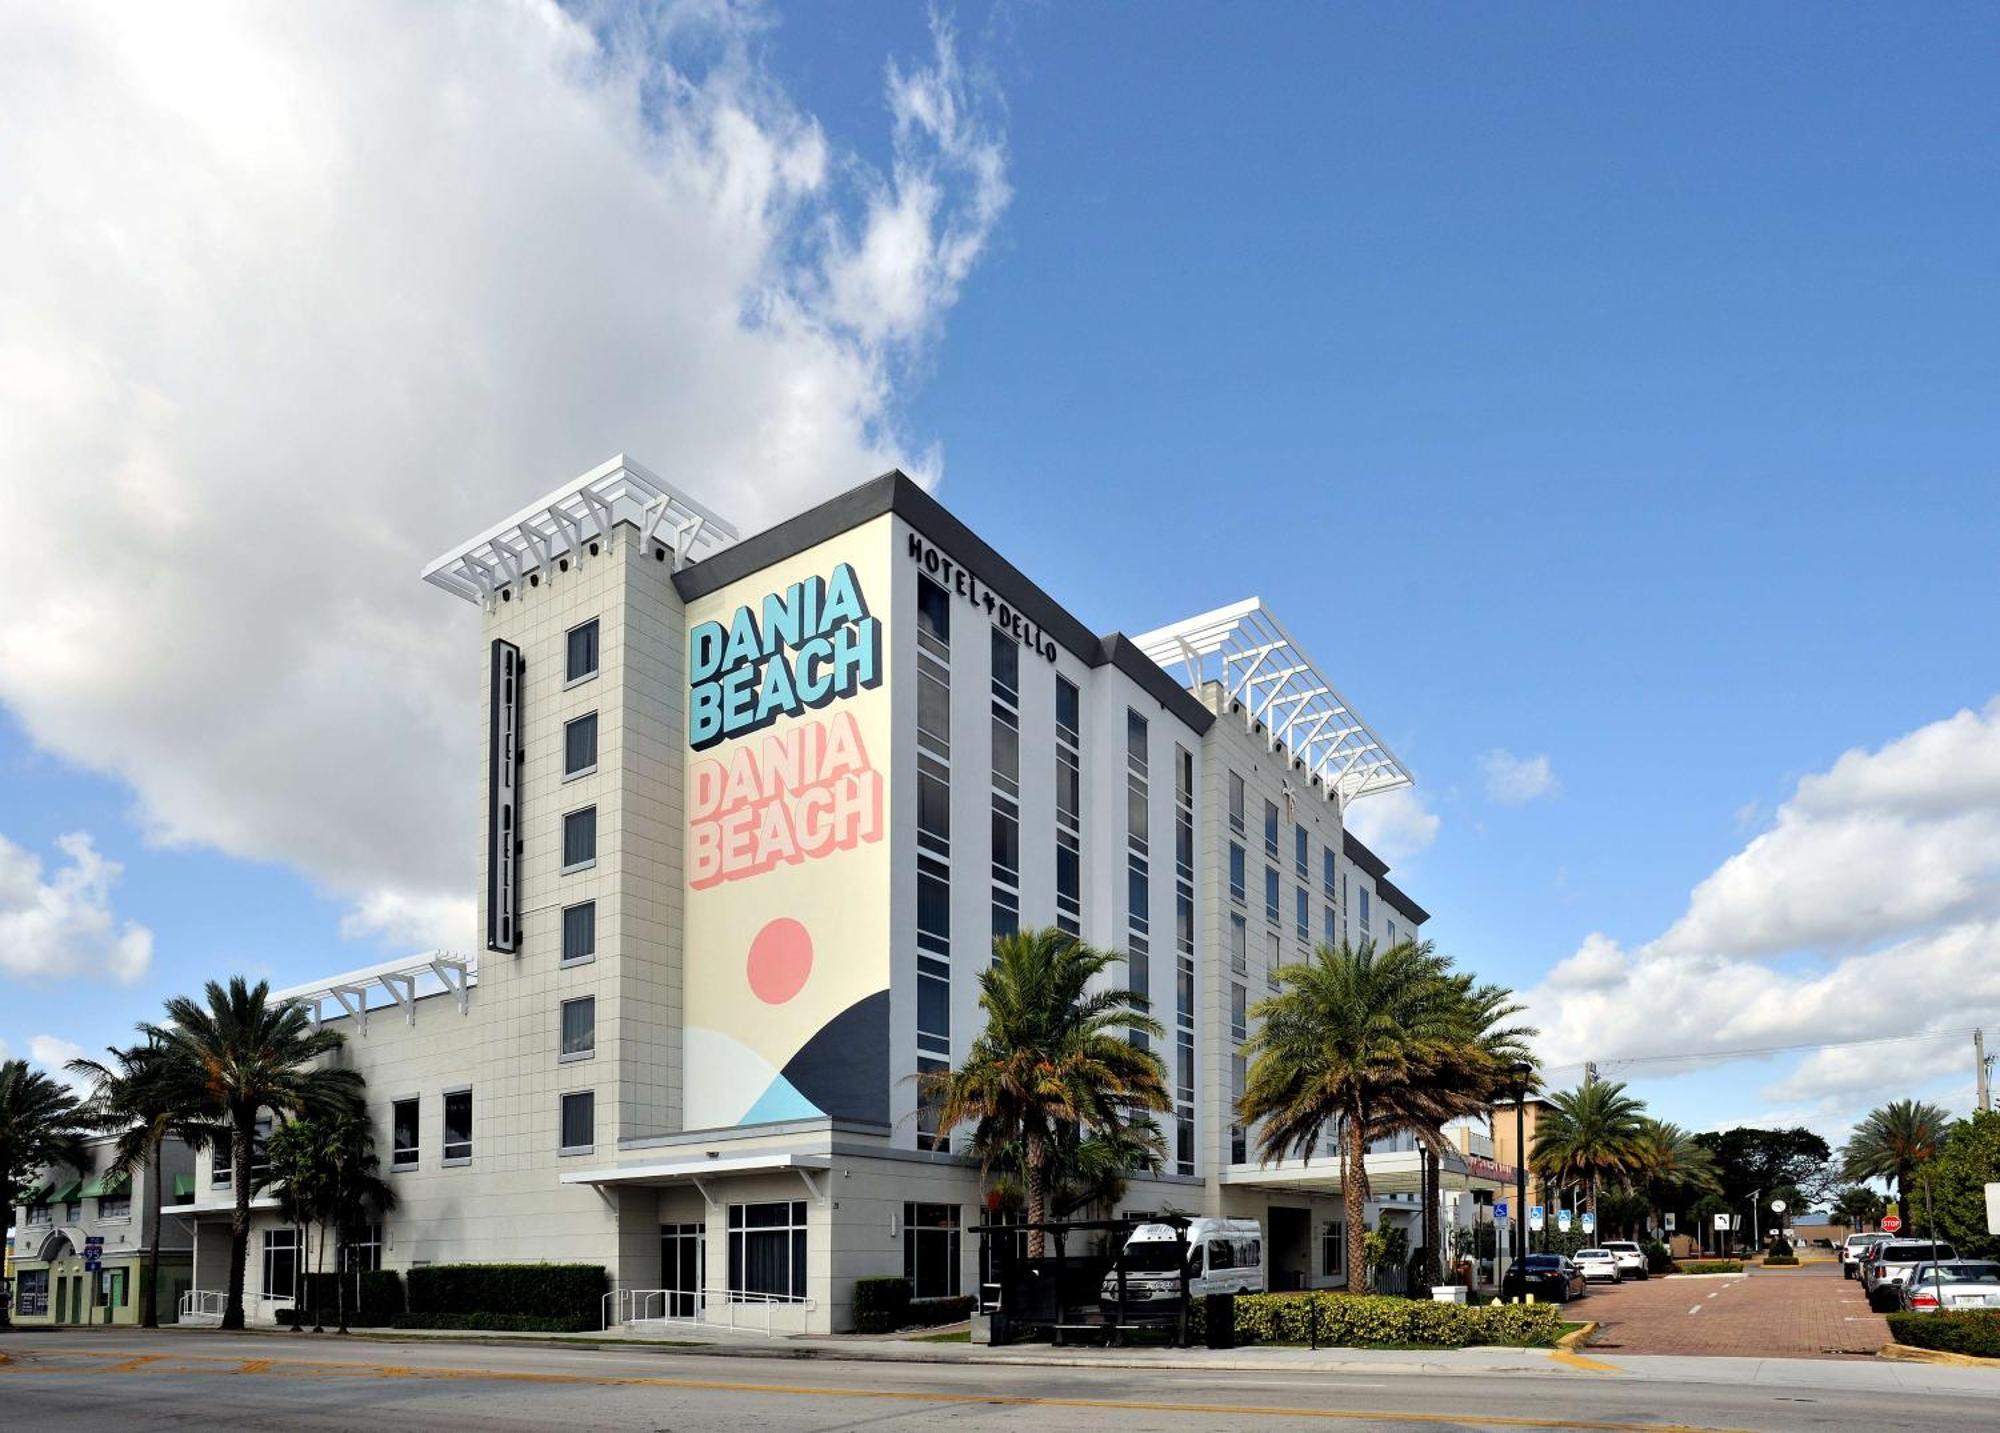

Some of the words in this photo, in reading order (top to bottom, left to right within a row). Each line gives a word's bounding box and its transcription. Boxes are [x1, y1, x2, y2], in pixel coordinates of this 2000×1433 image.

[690, 562, 872, 687] DANIA
[908, 533, 980, 607] HOTEL
[998, 602, 1057, 663] DELLO
[690, 616, 882, 752] BEACH
[690, 710, 872, 824] DANIA
[690, 770, 883, 891] BEACH
[87, 1249, 100, 1259] 95
